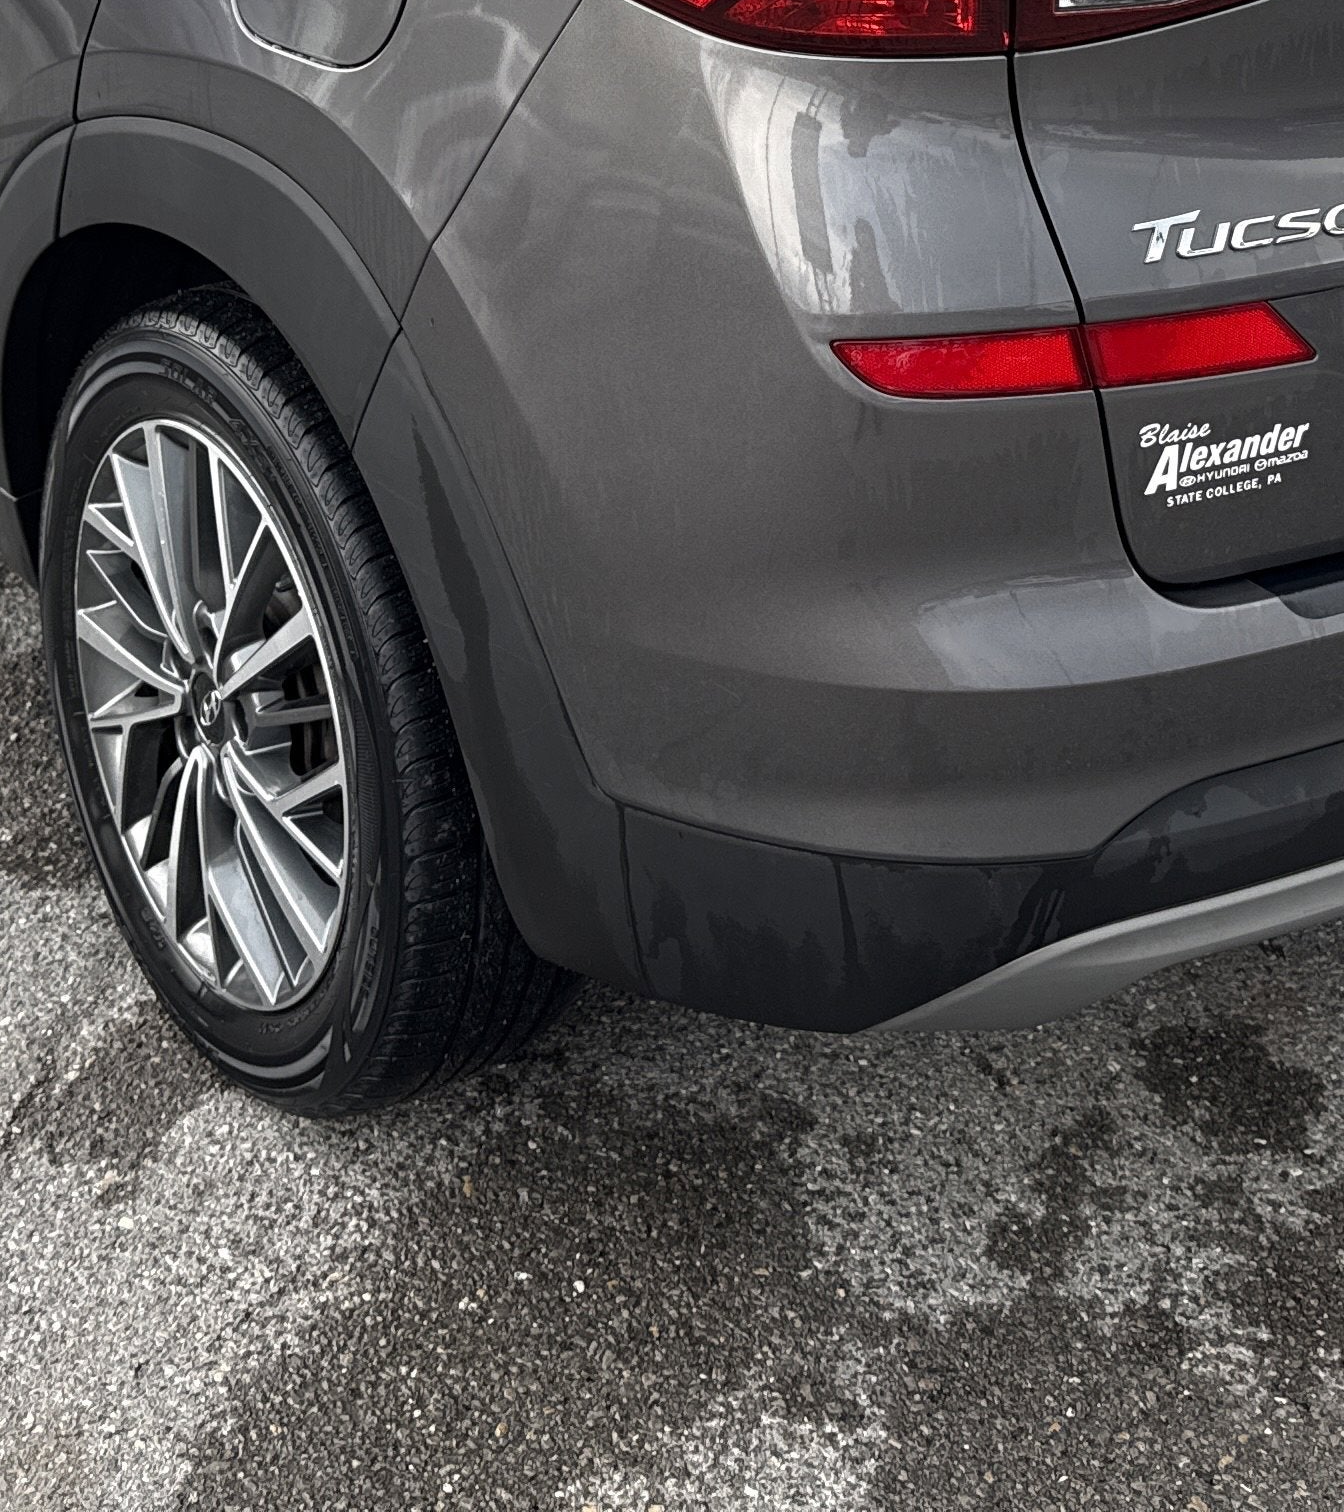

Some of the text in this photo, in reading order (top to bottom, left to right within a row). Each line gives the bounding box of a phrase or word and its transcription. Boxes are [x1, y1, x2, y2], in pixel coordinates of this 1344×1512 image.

[1138, 422, 1212, 448] Blaise
[1143, 422, 1310, 495] Alexander
[1196, 463, 1251, 484] HYUNDAI
[1166, 473, 1282, 508] STATE COLLEGE, PA
